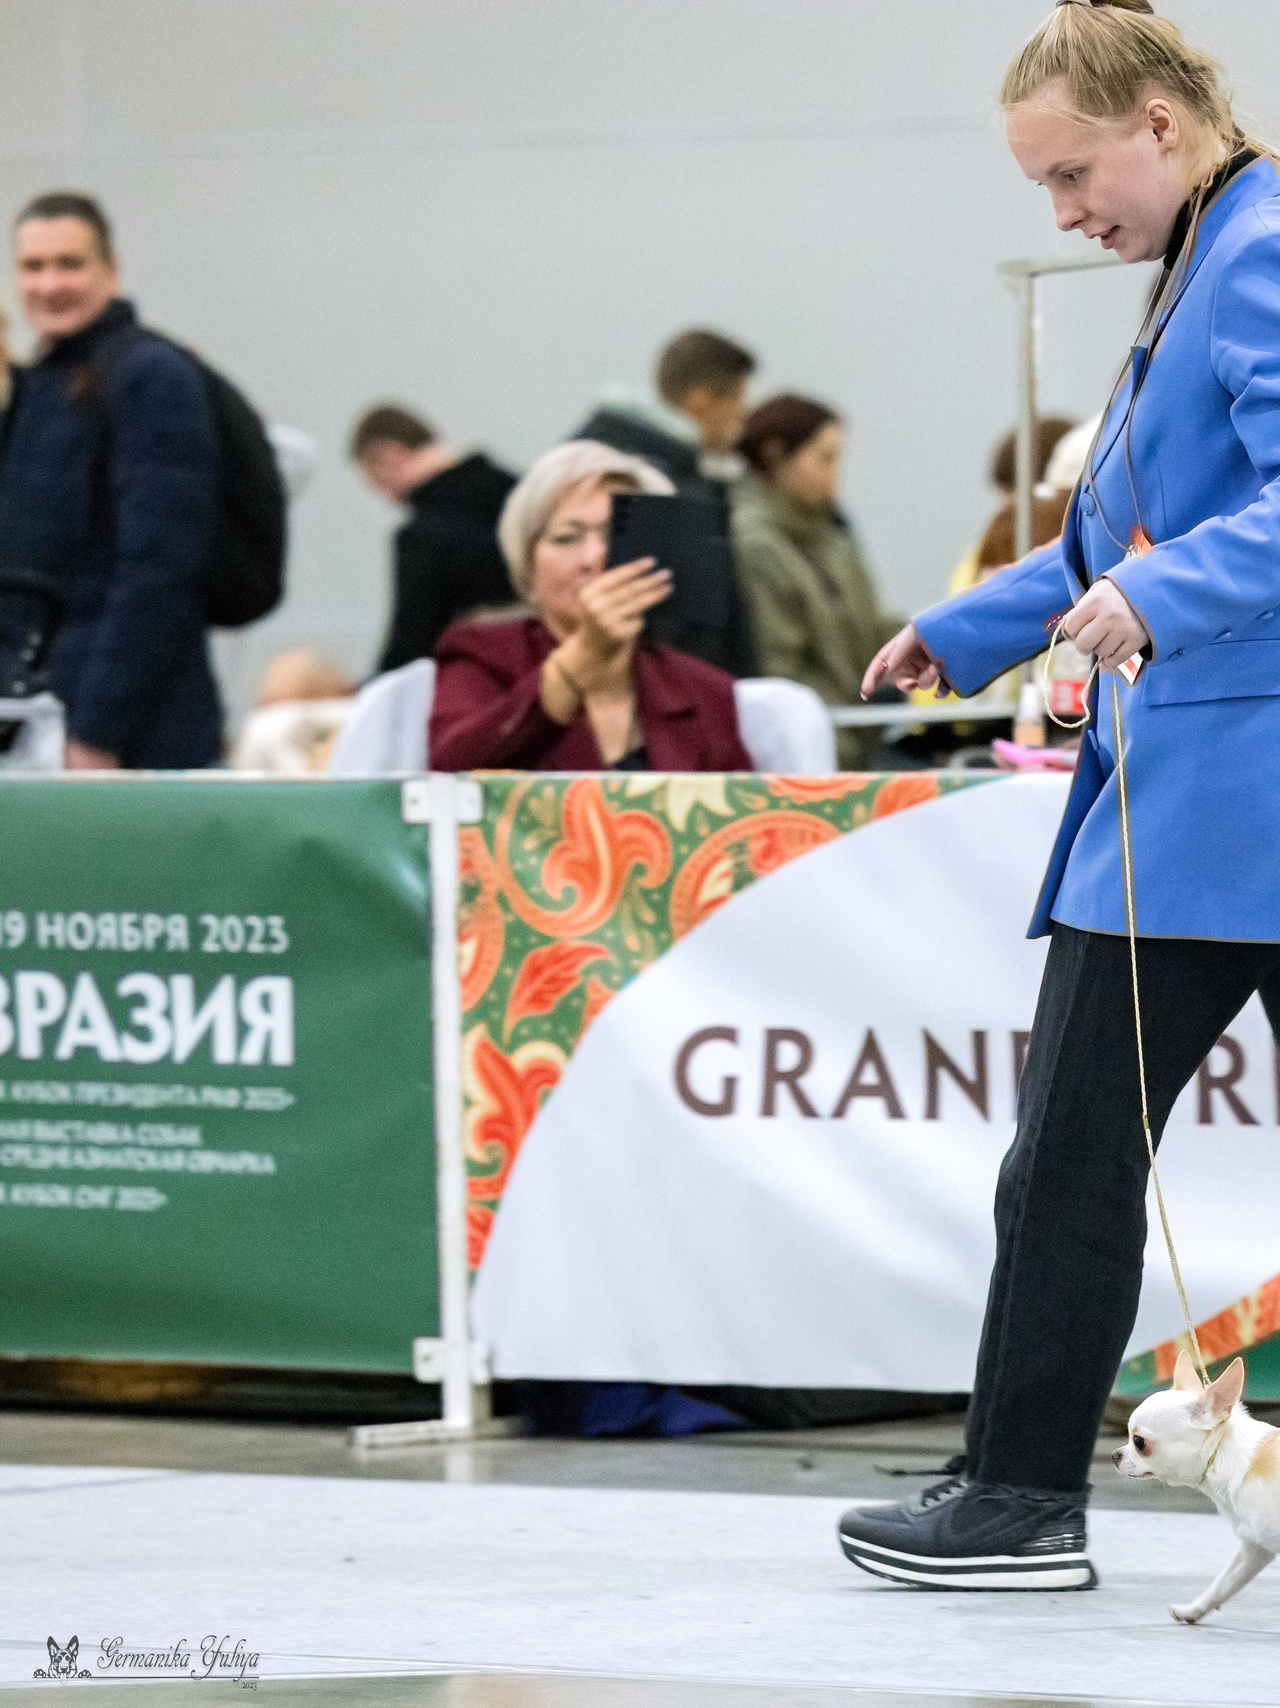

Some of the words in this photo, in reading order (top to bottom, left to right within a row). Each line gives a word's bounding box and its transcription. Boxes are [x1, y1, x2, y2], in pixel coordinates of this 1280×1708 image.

[0, 909, 28, 949] 9
[36, 911, 190, 951] НОЯБРЯ
[200, 914, 290, 954] 2023
[0, 971, 295, 1067] РАЗИЯ
